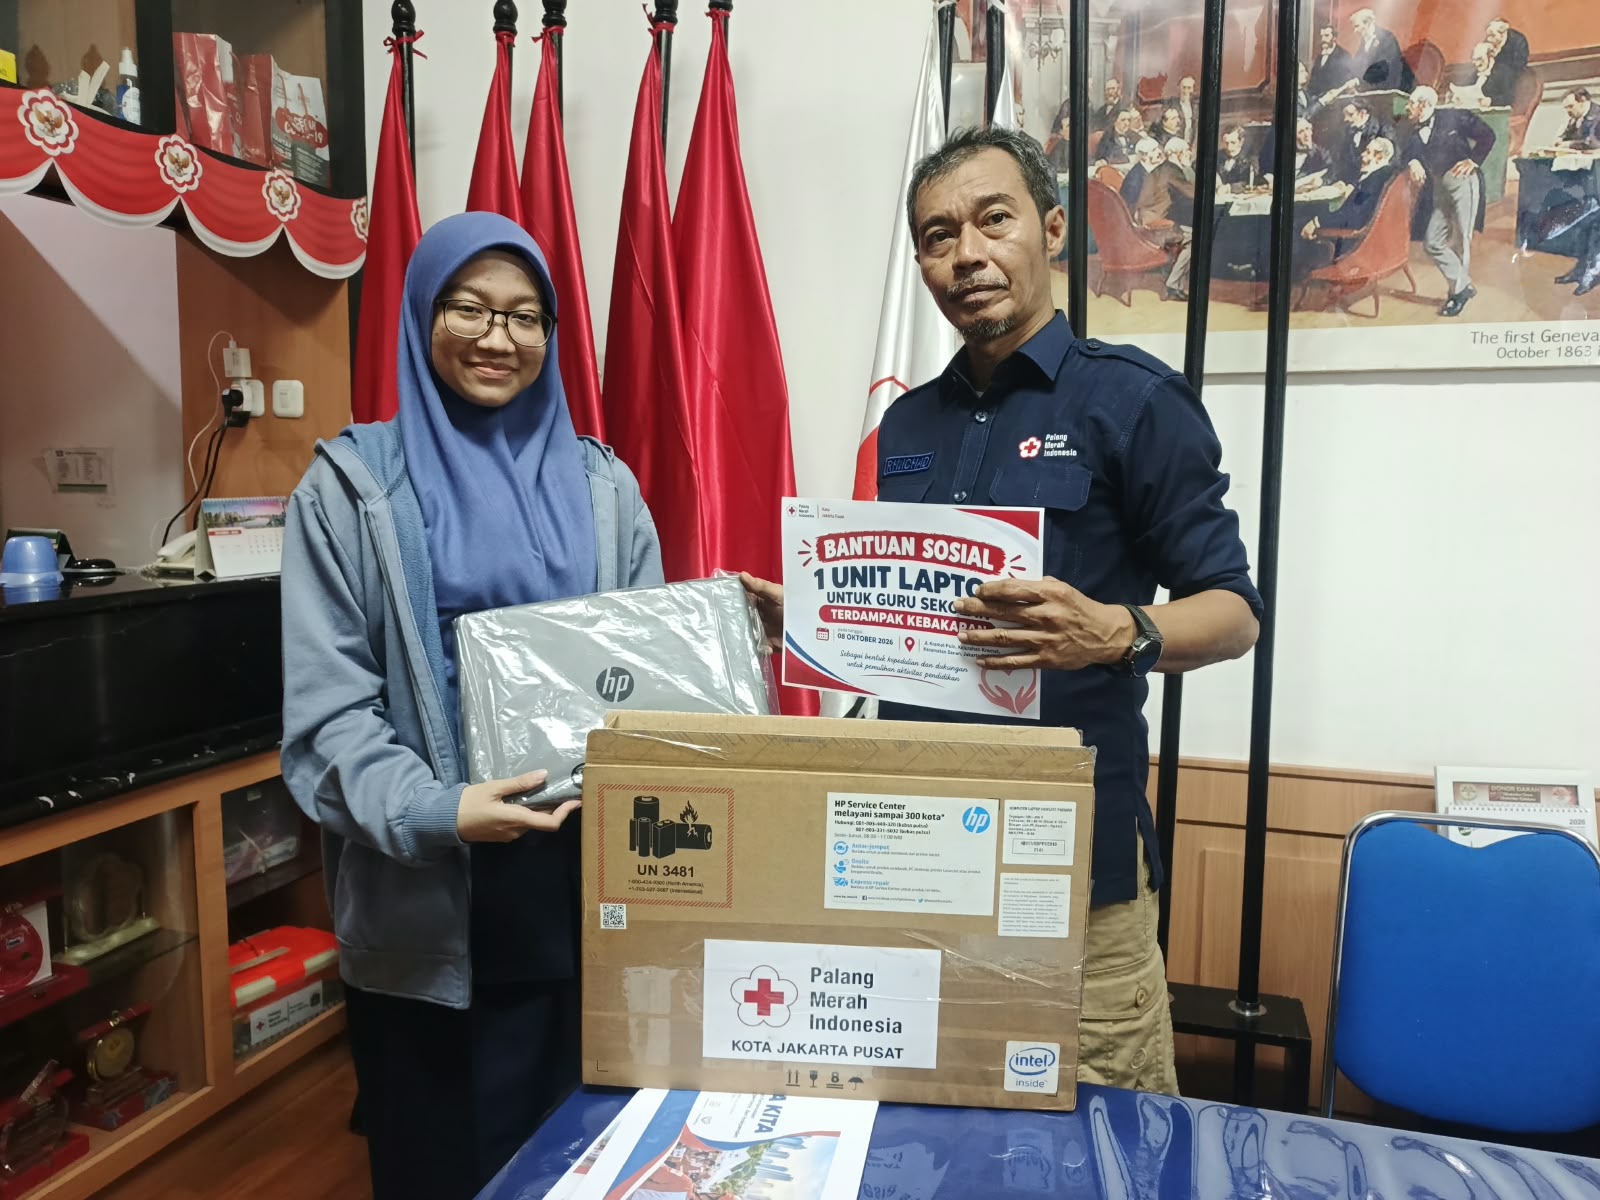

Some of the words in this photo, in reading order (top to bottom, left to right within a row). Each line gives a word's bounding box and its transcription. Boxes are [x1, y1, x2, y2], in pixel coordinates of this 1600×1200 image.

[1470, 331, 1499, 344] The
[1504, 330, 1535, 343] first
[1541, 329, 1599, 343] Geneva
[1496, 346, 1550, 359] October
[1557, 346, 1592, 358] 1863
[1044, 441, 1065, 449] Merah
[1046, 433, 1068, 442] Palang
[1043, 448, 1077, 457] Indonesia
[824, 535, 915, 559] BANTUAN
[922, 538, 994, 571] SOSIAL
[814, 568, 824, 589] 1
[831, 565, 891, 588] UNIT
[899, 566, 984, 598] LAPTO
[827, 591, 872, 605] UNTUK
[876, 593, 916, 608] GURU
[830, 609, 904, 625] TERDAMPAK
[847, 634, 877, 643] OKTOBER
[840, 650, 863, 660] Sebagai
[865, 653, 886, 662] bentuk
[887, 655, 919, 666] kepedulian
[935, 662, 968, 673] dukungan
[864, 664, 895, 673] pemulihan
[897, 667, 923, 676] aktivitas
[924, 672, 960, 682] pendidikan
[602, 667, 630, 703] hp
[834, 800, 846, 808] HP
[847, 801, 877, 809] Service
[879, 802, 906, 810] Center
[834, 809, 872, 819] melayani
[874, 812, 904, 820] sampai
[905, 812, 921, 820] 300
[964, 806, 989, 833] hp
[637, 864, 658, 876] UN
[662, 865, 694, 878] 3481
[810, 967, 874, 989] Palang
[810, 991, 867, 1009] Merah
[809, 1014, 902, 1034] Indonesia
[732, 1039, 772, 1053] KOTA
[777, 1042, 849, 1057] JAKARTA
[853, 1046, 904, 1059] PUSAT
[1015, 1053, 1048, 1067] intel
[1015, 1078, 1045, 1088] inside
[754, 1104, 783, 1133] KITA
